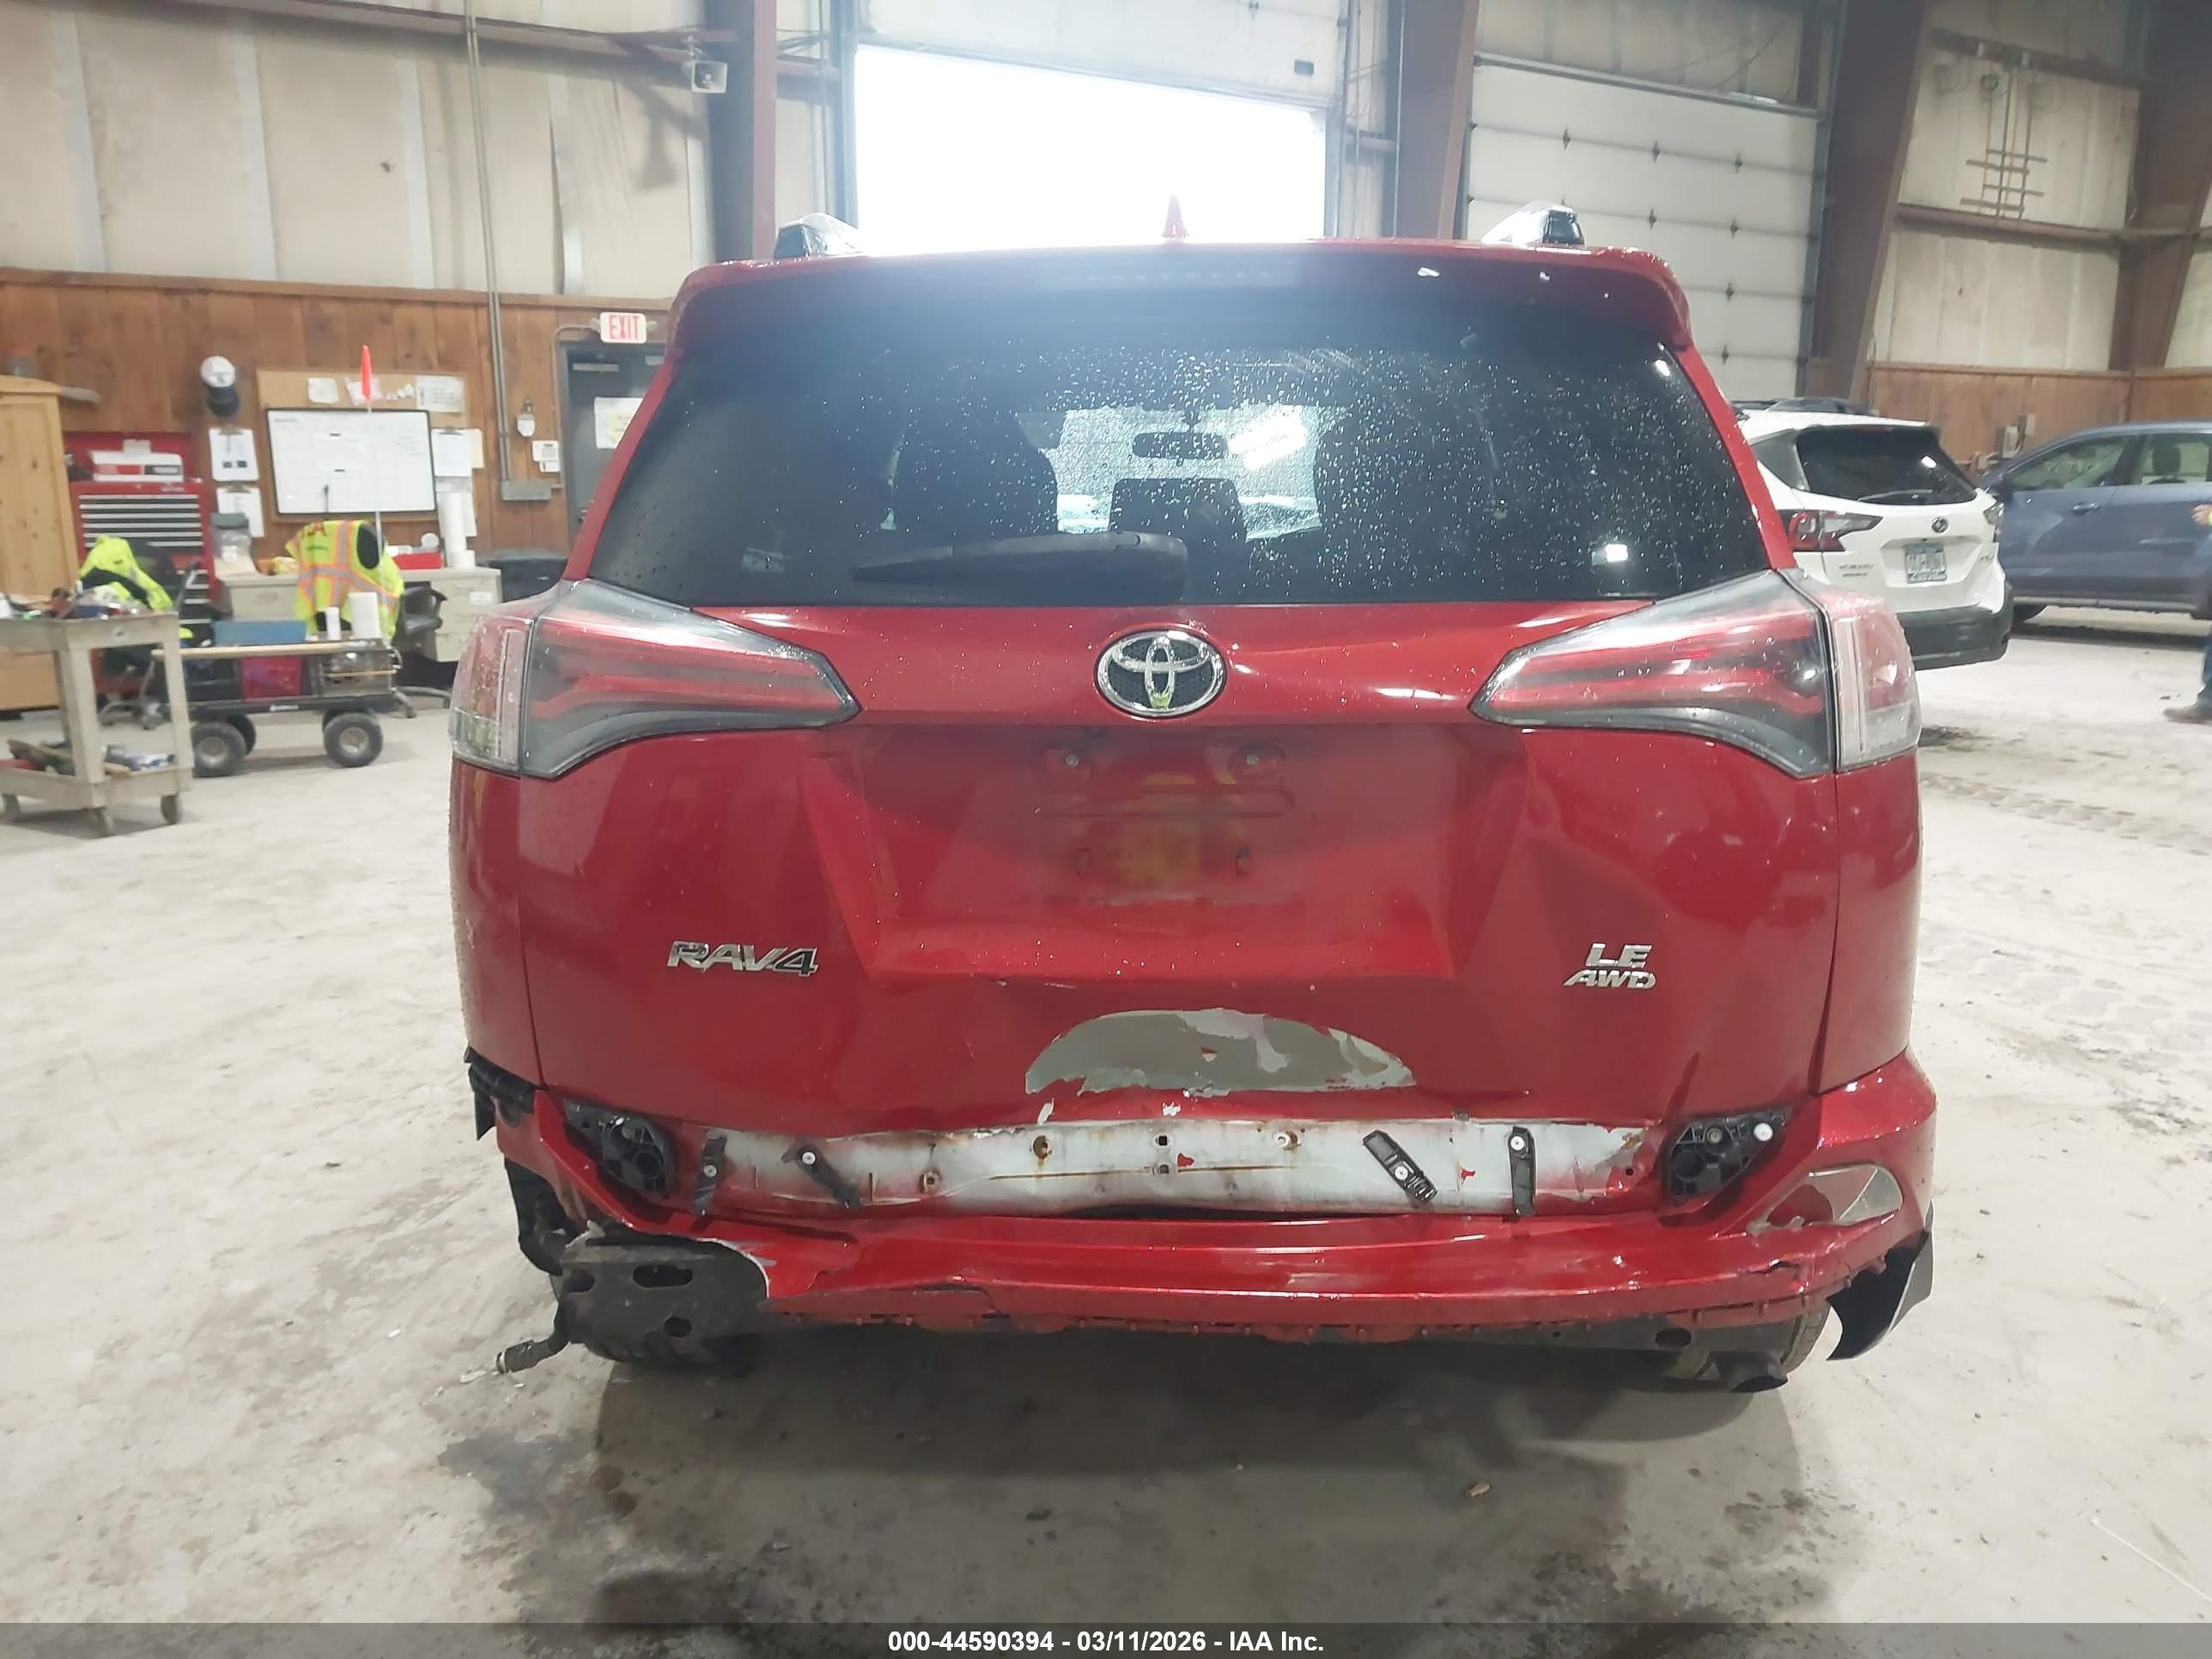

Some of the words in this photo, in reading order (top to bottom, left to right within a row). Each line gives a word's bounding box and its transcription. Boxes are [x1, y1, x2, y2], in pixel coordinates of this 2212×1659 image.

[609, 314, 640, 340] EXIT
[666, 940, 819, 976] RAV4
[1585, 942, 1652, 969] LE
[1563, 969, 1656, 989] AWD
